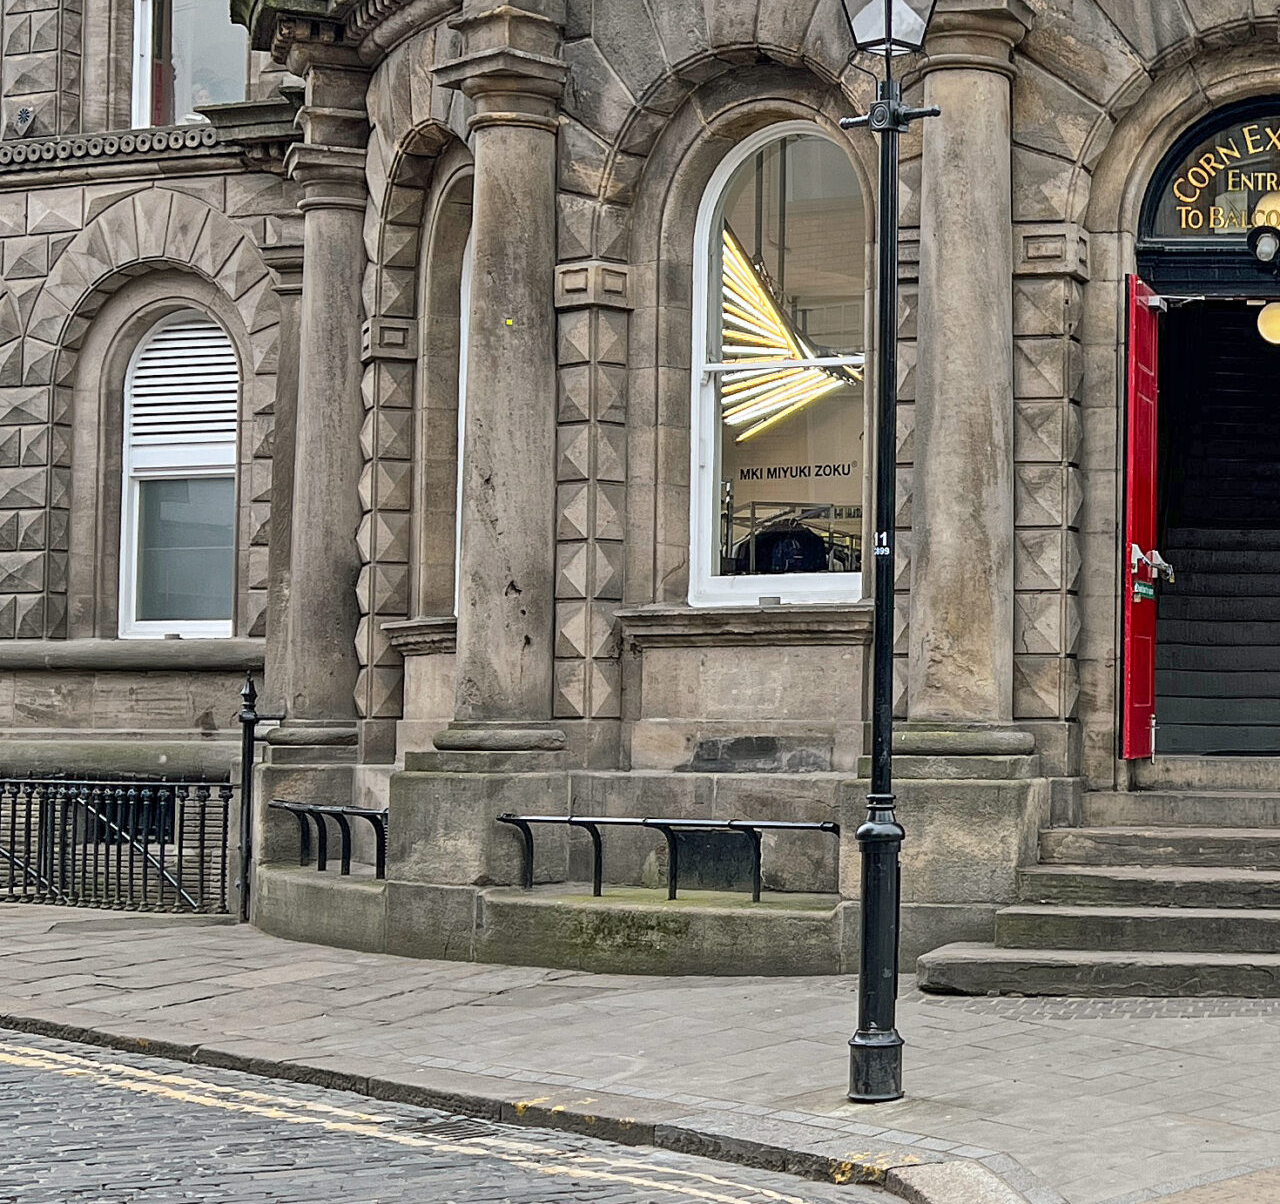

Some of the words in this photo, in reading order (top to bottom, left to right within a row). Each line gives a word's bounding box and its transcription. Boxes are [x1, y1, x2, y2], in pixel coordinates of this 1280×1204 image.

[1173, 138, 1241, 202] CORN
[1176, 206, 1204, 229] TO
[740, 468, 763, 480] MKI
[766, 466, 812, 479] MIYUKI
